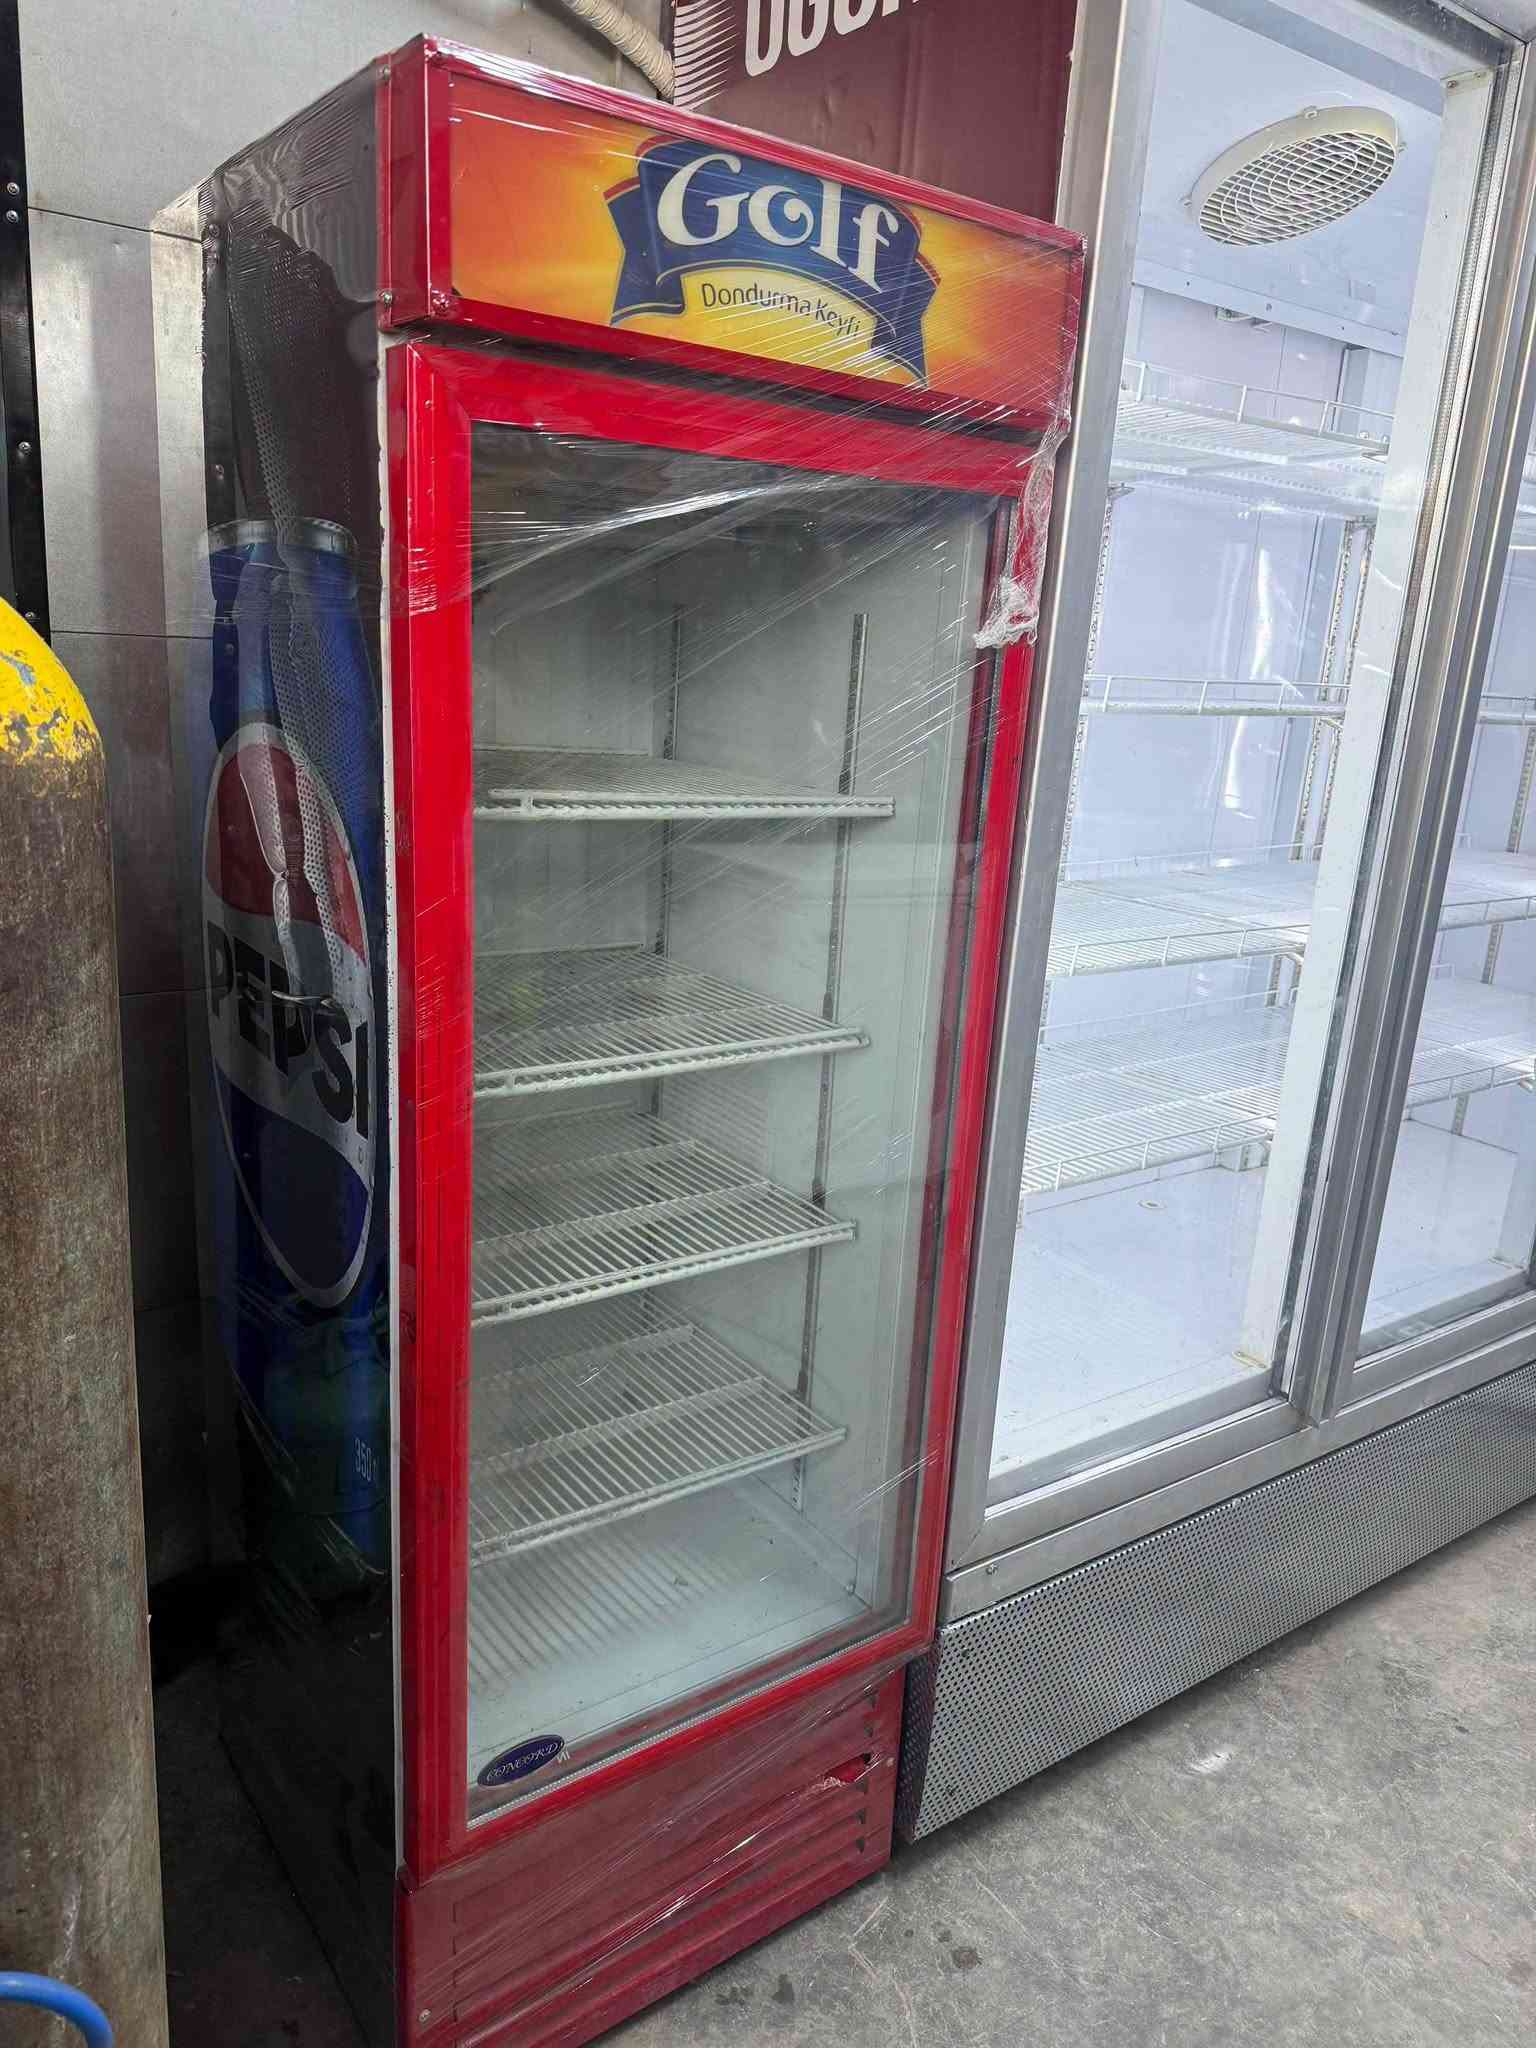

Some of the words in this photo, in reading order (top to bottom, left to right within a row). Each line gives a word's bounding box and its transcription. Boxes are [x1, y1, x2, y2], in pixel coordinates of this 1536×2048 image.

[656, 152, 900, 293] Golf
[701, 282, 812, 317] Dondurma
[815, 296, 861, 338] Keyfi
[207, 919, 369, 1141] PEPSI
